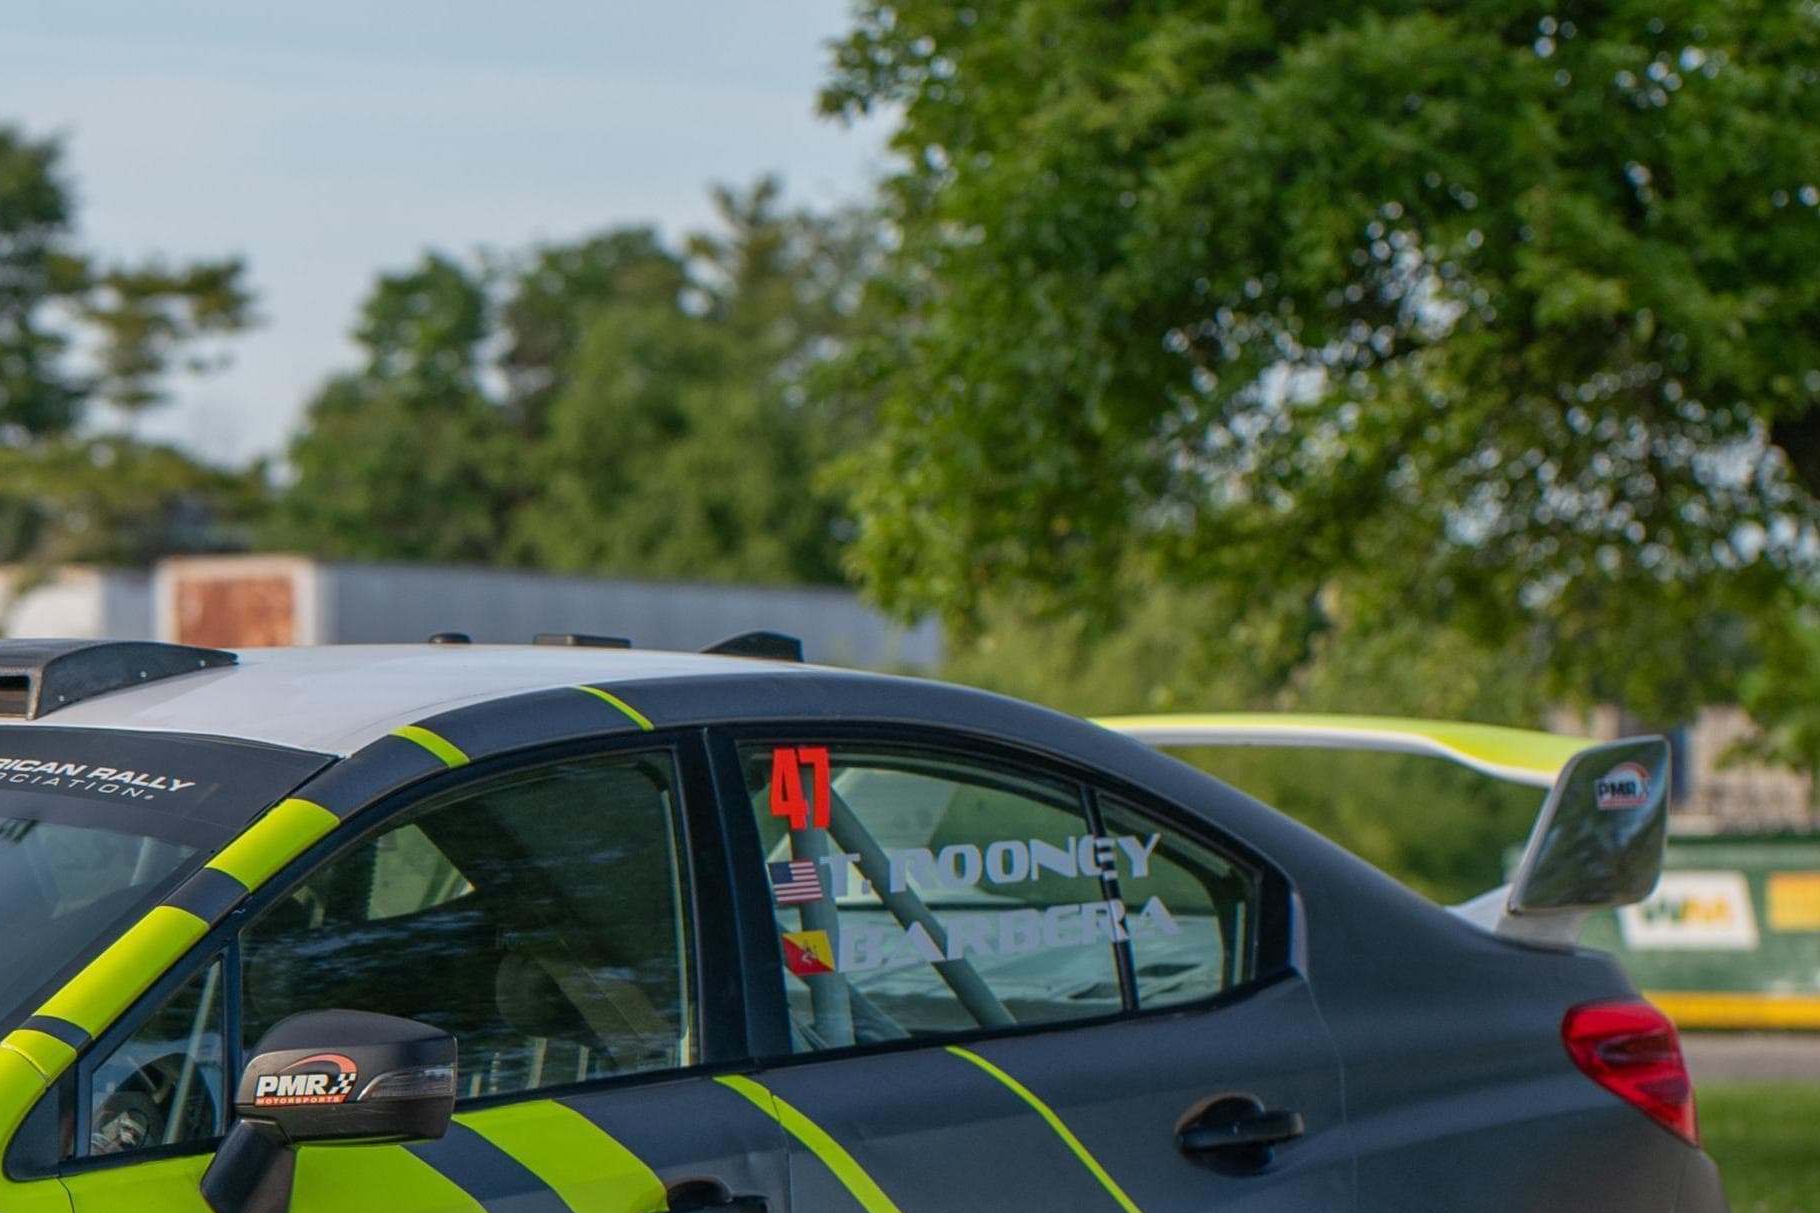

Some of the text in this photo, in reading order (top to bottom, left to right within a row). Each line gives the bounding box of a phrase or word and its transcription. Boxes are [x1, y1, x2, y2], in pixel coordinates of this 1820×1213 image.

[85, 767, 196, 793] RALLY
[770, 746, 831, 831] 47
[889, 832, 1161, 893] ROONEY
[837, 895, 1180, 973] BARBERA
[255, 1096, 341, 1106] MOTORSPORTS
[256, 1074, 328, 1096] PMR
